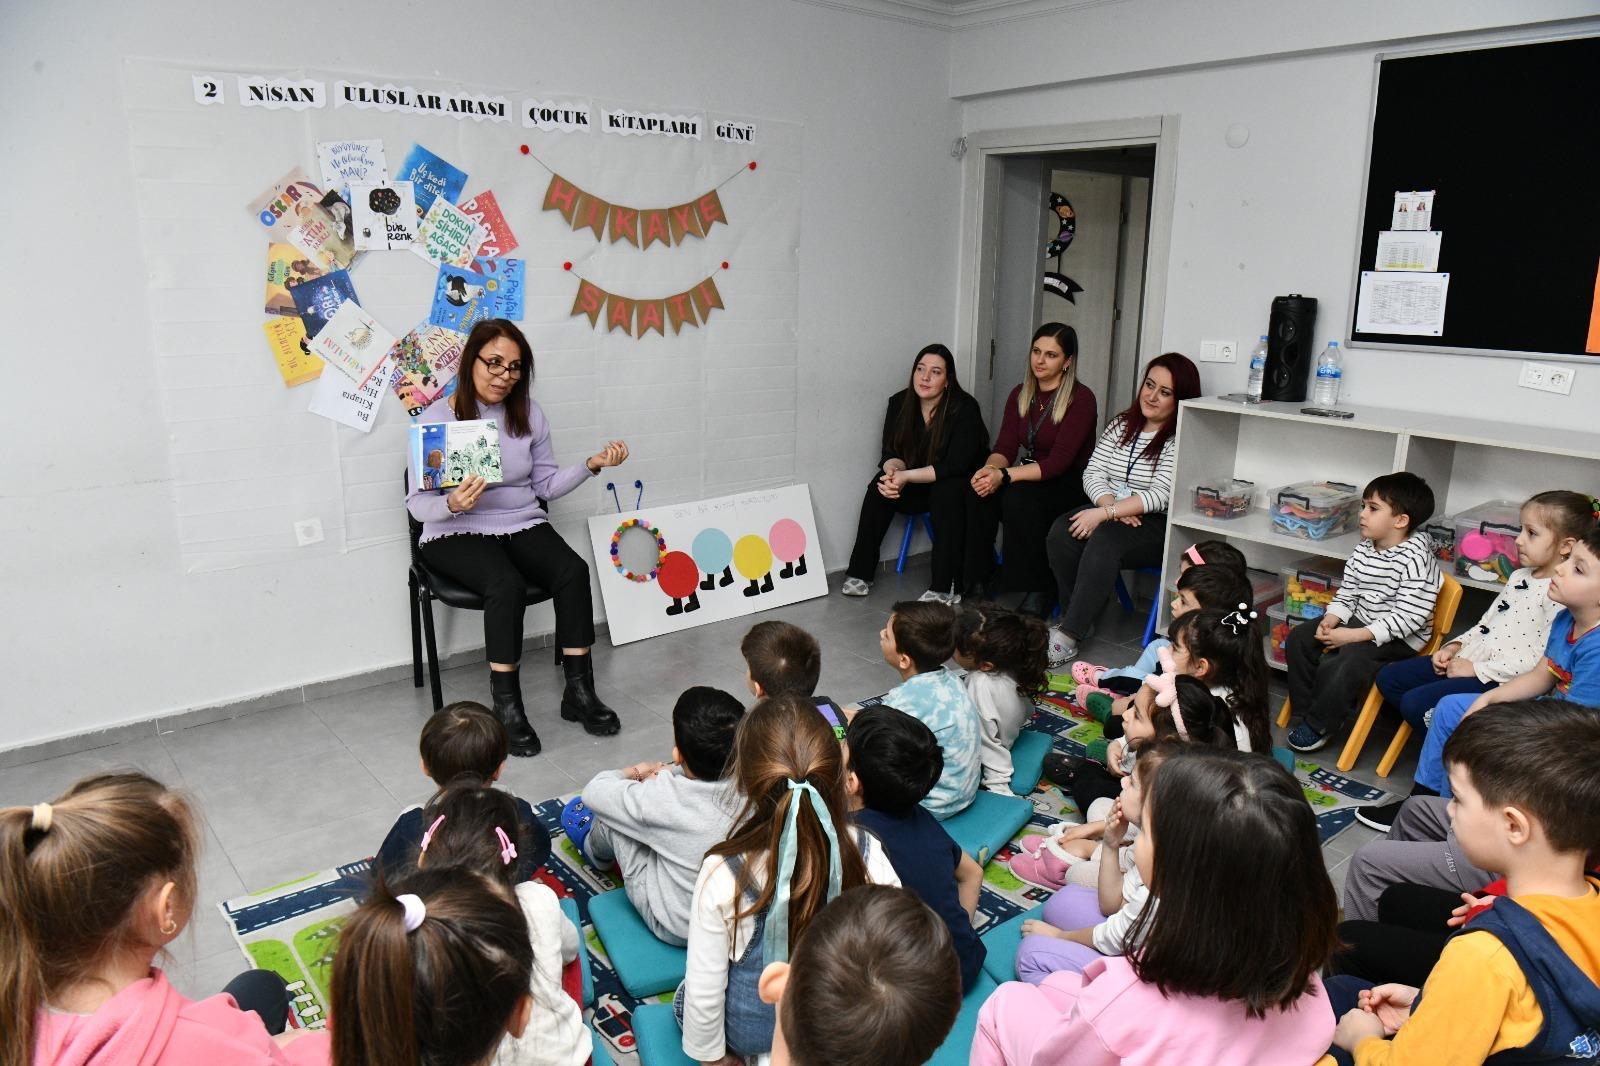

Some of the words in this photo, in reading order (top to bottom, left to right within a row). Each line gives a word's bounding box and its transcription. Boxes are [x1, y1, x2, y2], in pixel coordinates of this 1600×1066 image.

[203, 82, 218, 98] 2
[248, 83, 315, 103] NİSAN
[528, 106, 588, 125] ÇOCUK
[608, 113, 698, 135] KİTAPLARI
[716, 122, 756, 142] GÜNÜ
[303, 221, 326, 247] ATIM
[435, 219, 470, 246] SİHİRLİ
[442, 208, 474, 235] DOKUN
[429, 231, 461, 257] AĞACA
[503, 279, 519, 319] Paytak
[342, 390, 374, 410] Kitapta
[358, 410, 369, 422] Bu
